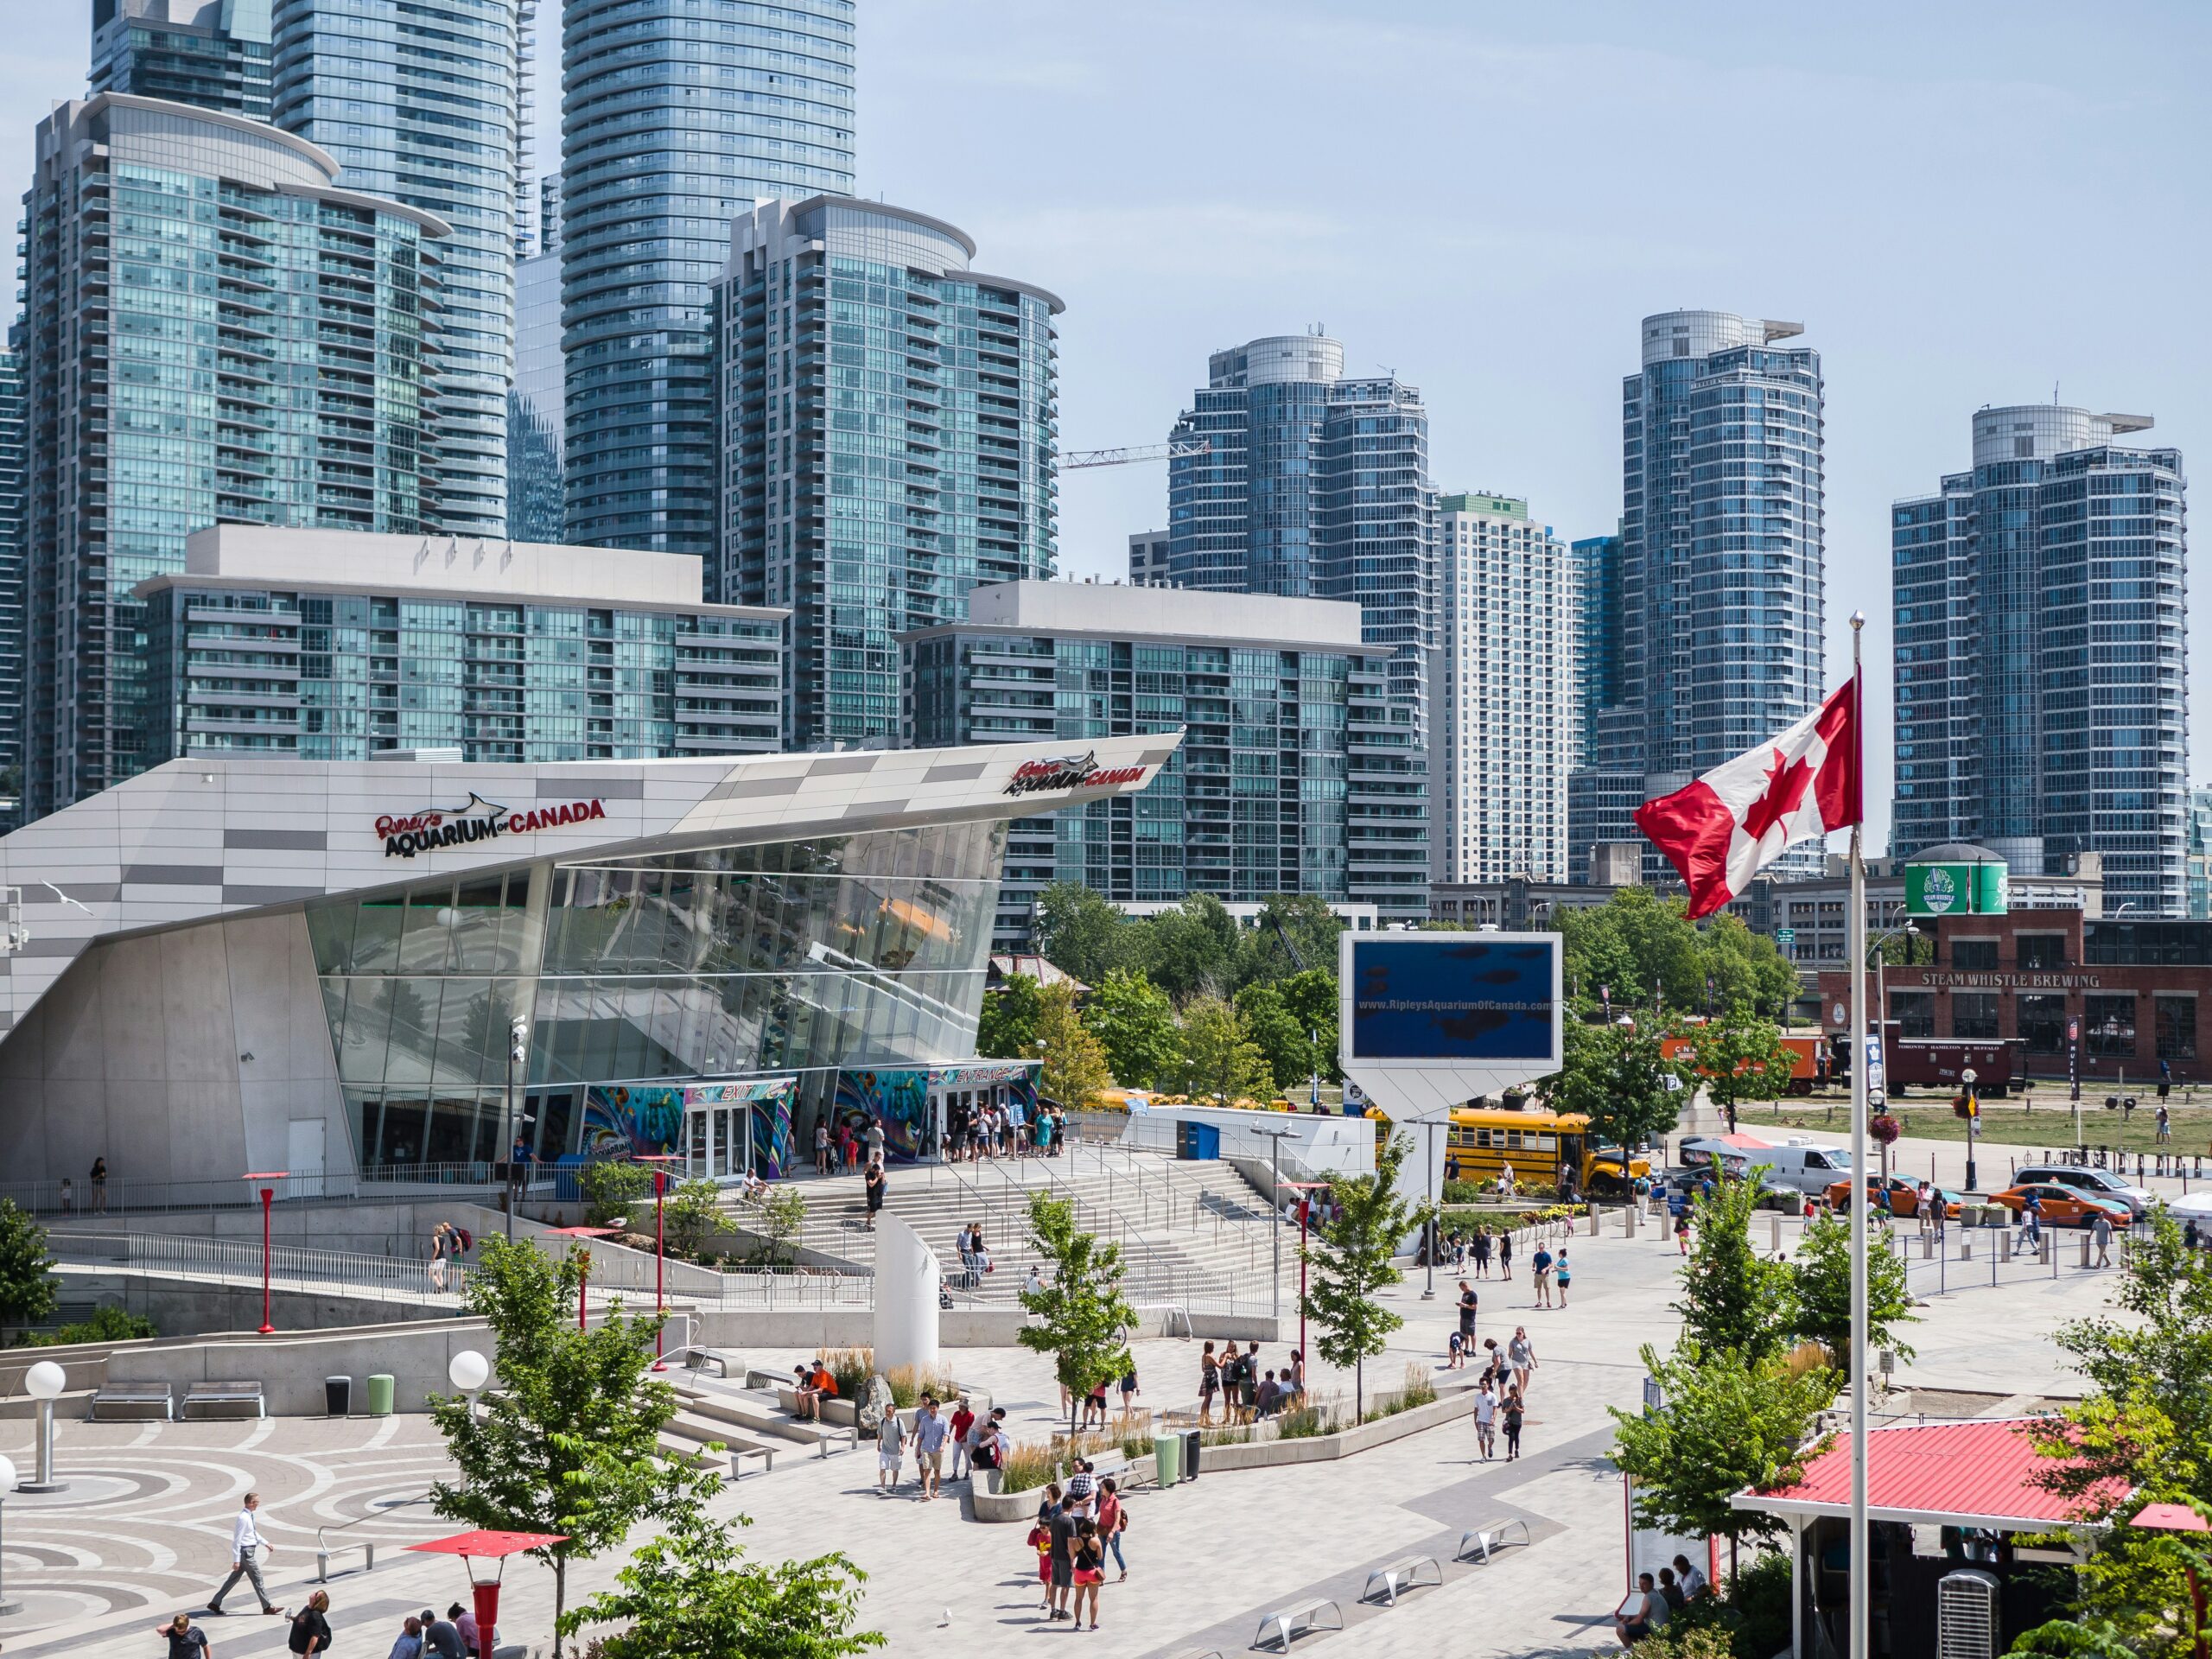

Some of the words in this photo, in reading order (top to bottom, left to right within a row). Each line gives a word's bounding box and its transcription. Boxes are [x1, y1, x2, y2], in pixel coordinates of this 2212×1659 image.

[1084, 766, 1147, 787] CANADA
[375, 814, 443, 840] Ripley's
[385, 817, 498, 858] AQUARIUM
[497, 822, 509, 832] OF
[509, 798, 606, 834] CANADA
[1922, 973, 1964, 986] STEAM
[1967, 974, 2028, 987] WHISTLE
[2033, 975, 2100, 988] BREWING
[1358, 999, 1552, 1012] www.RipleysAquariumOfCanada.com
[957, 1067, 1009, 1084] ENTRANCE
[721, 1084, 754, 1100] EXIT
